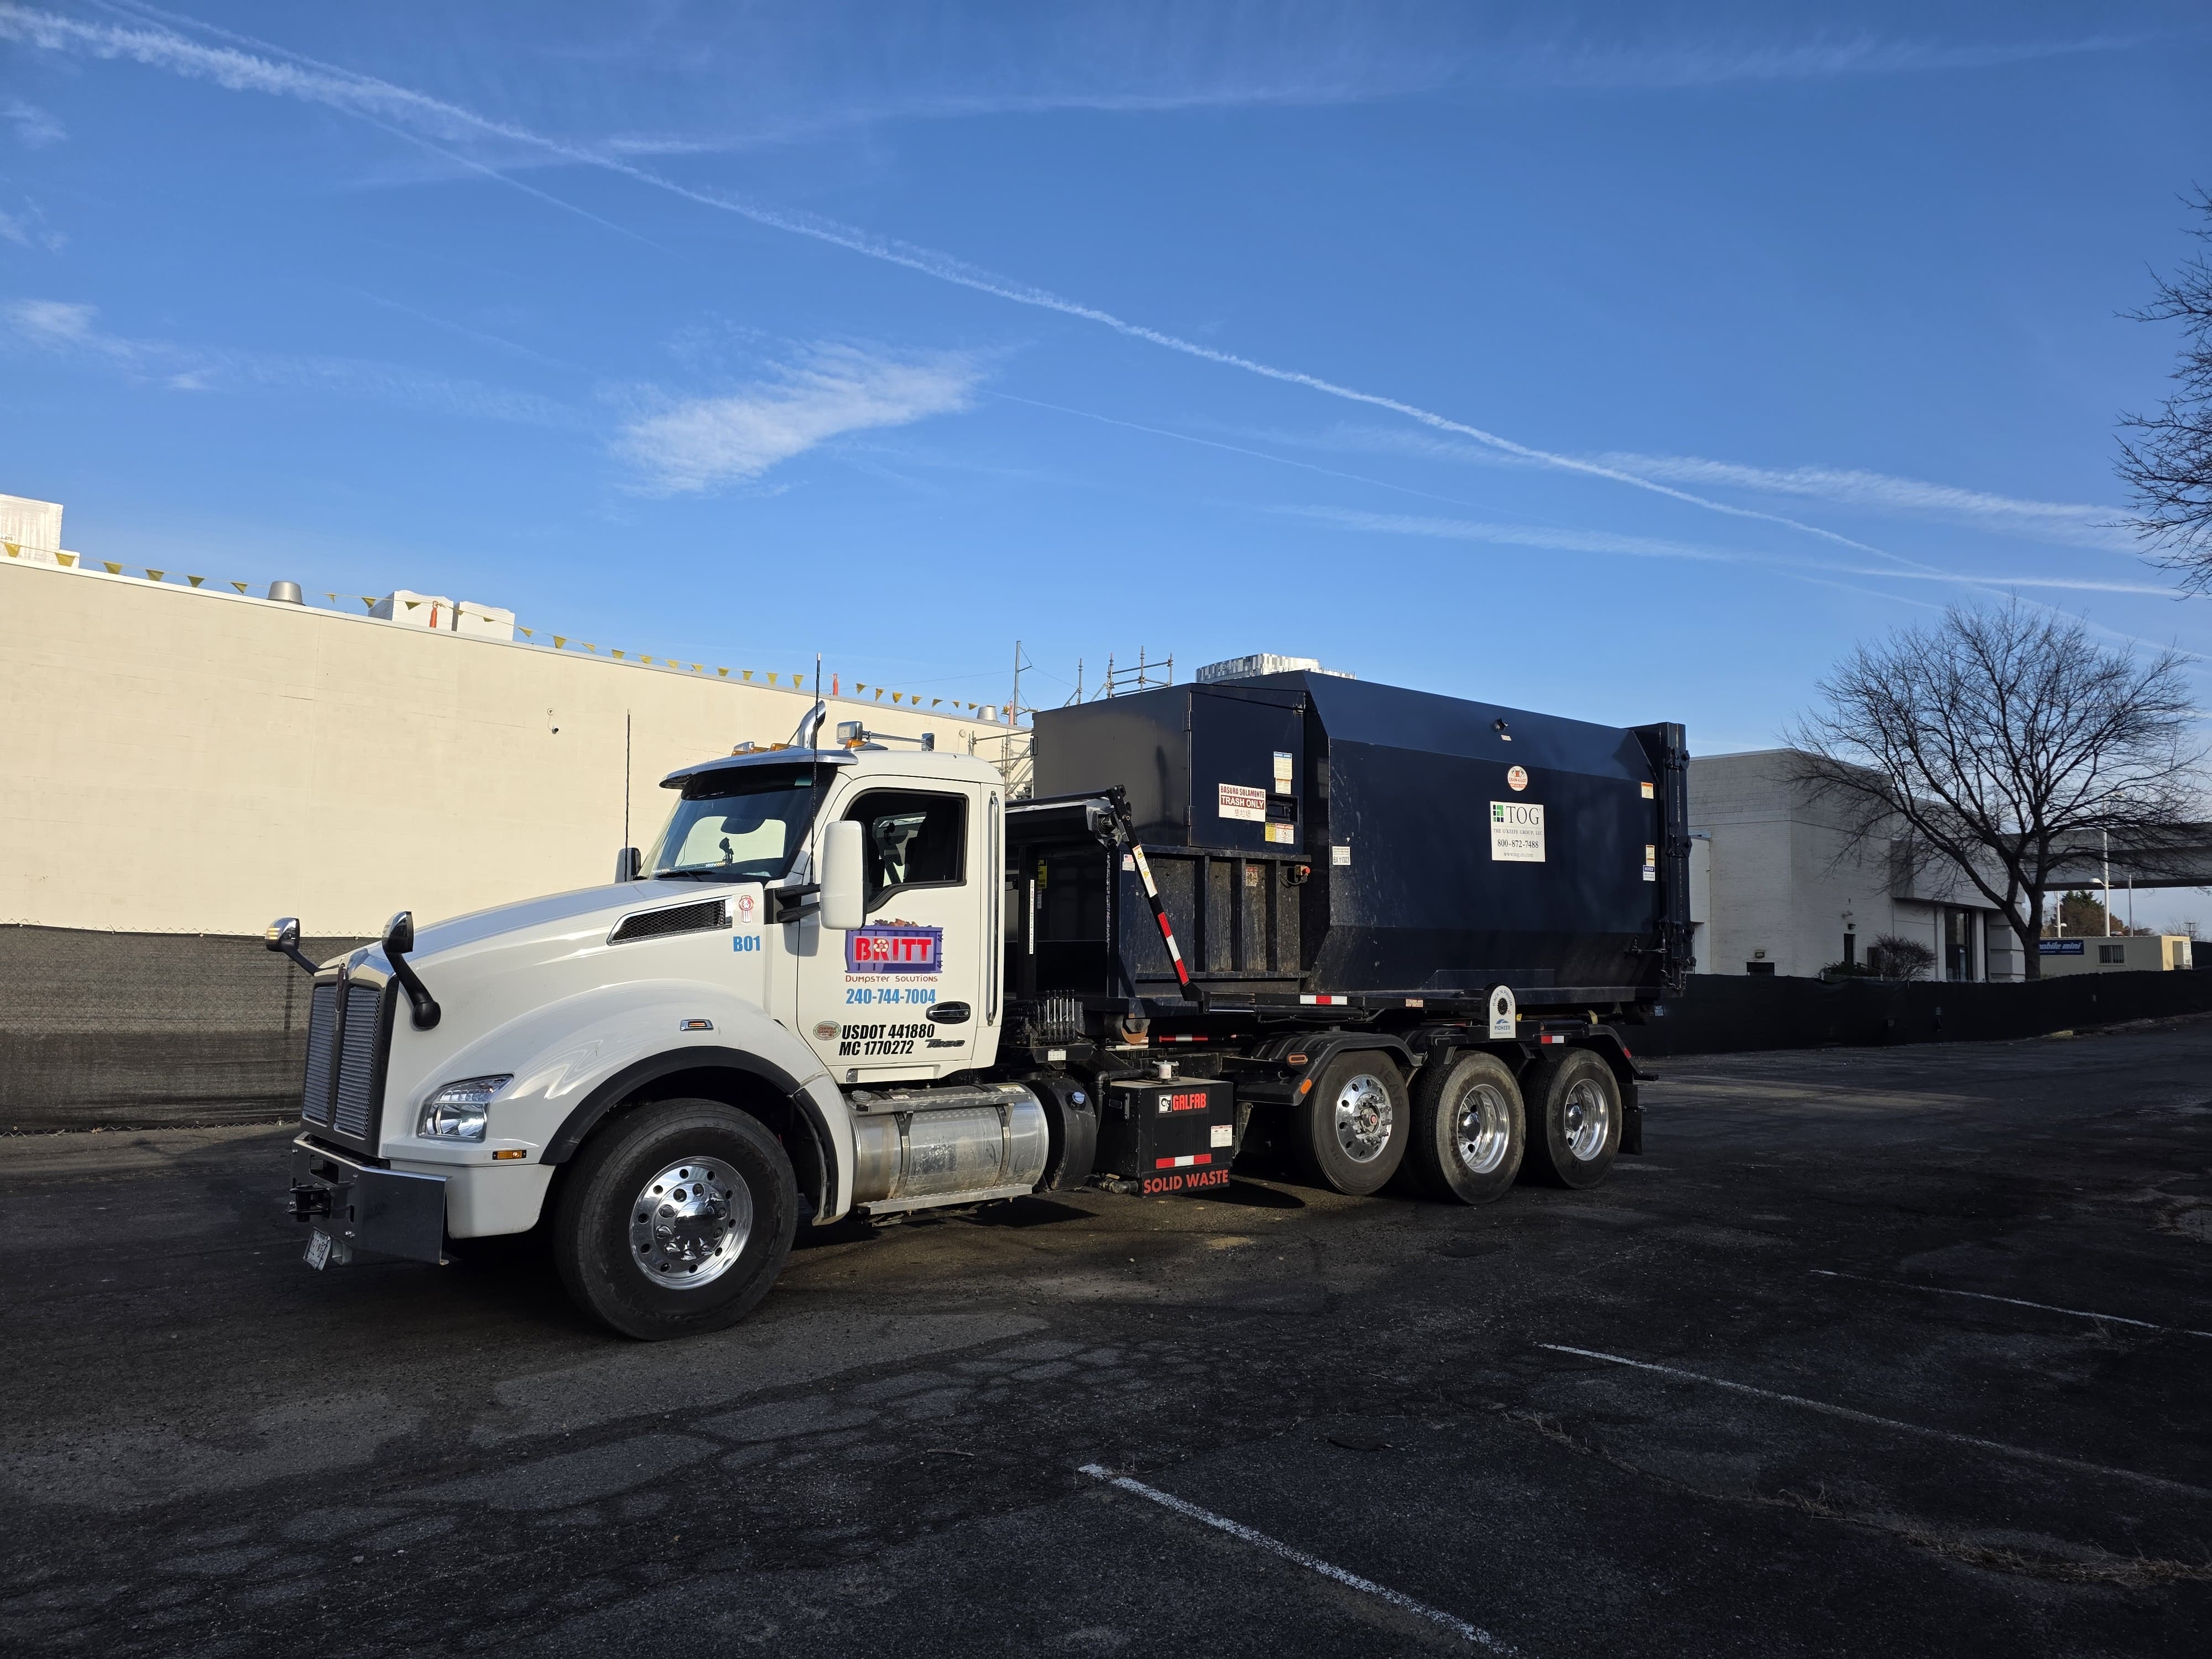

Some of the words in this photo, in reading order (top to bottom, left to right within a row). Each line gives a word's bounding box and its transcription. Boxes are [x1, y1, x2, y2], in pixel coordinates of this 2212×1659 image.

[1220, 785, 1239, 795] BASURA
[1221, 796, 1245, 807] TRASH
[1246, 799, 1264, 809] ONLY
[1506, 806, 1540, 825] TOG
[1498, 839, 1538, 848] 800-872-7488
[733, 936, 760, 952] B01
[854, 938, 932, 962] BRITT
[846, 988, 936, 1004] 240-744-7004
[842, 1025, 886, 1040] USDOT
[888, 1024, 935, 1039] 441880
[839, 1041, 861, 1056] MC
[864, 1040, 914, 1056] 1770272
[925, 1039, 966, 1048] T880
[1172, 1093, 1207, 1111] GALFAB
[1144, 1176, 1183, 1194] SOLID
[1186, 1169, 1228, 1188] WASTE
